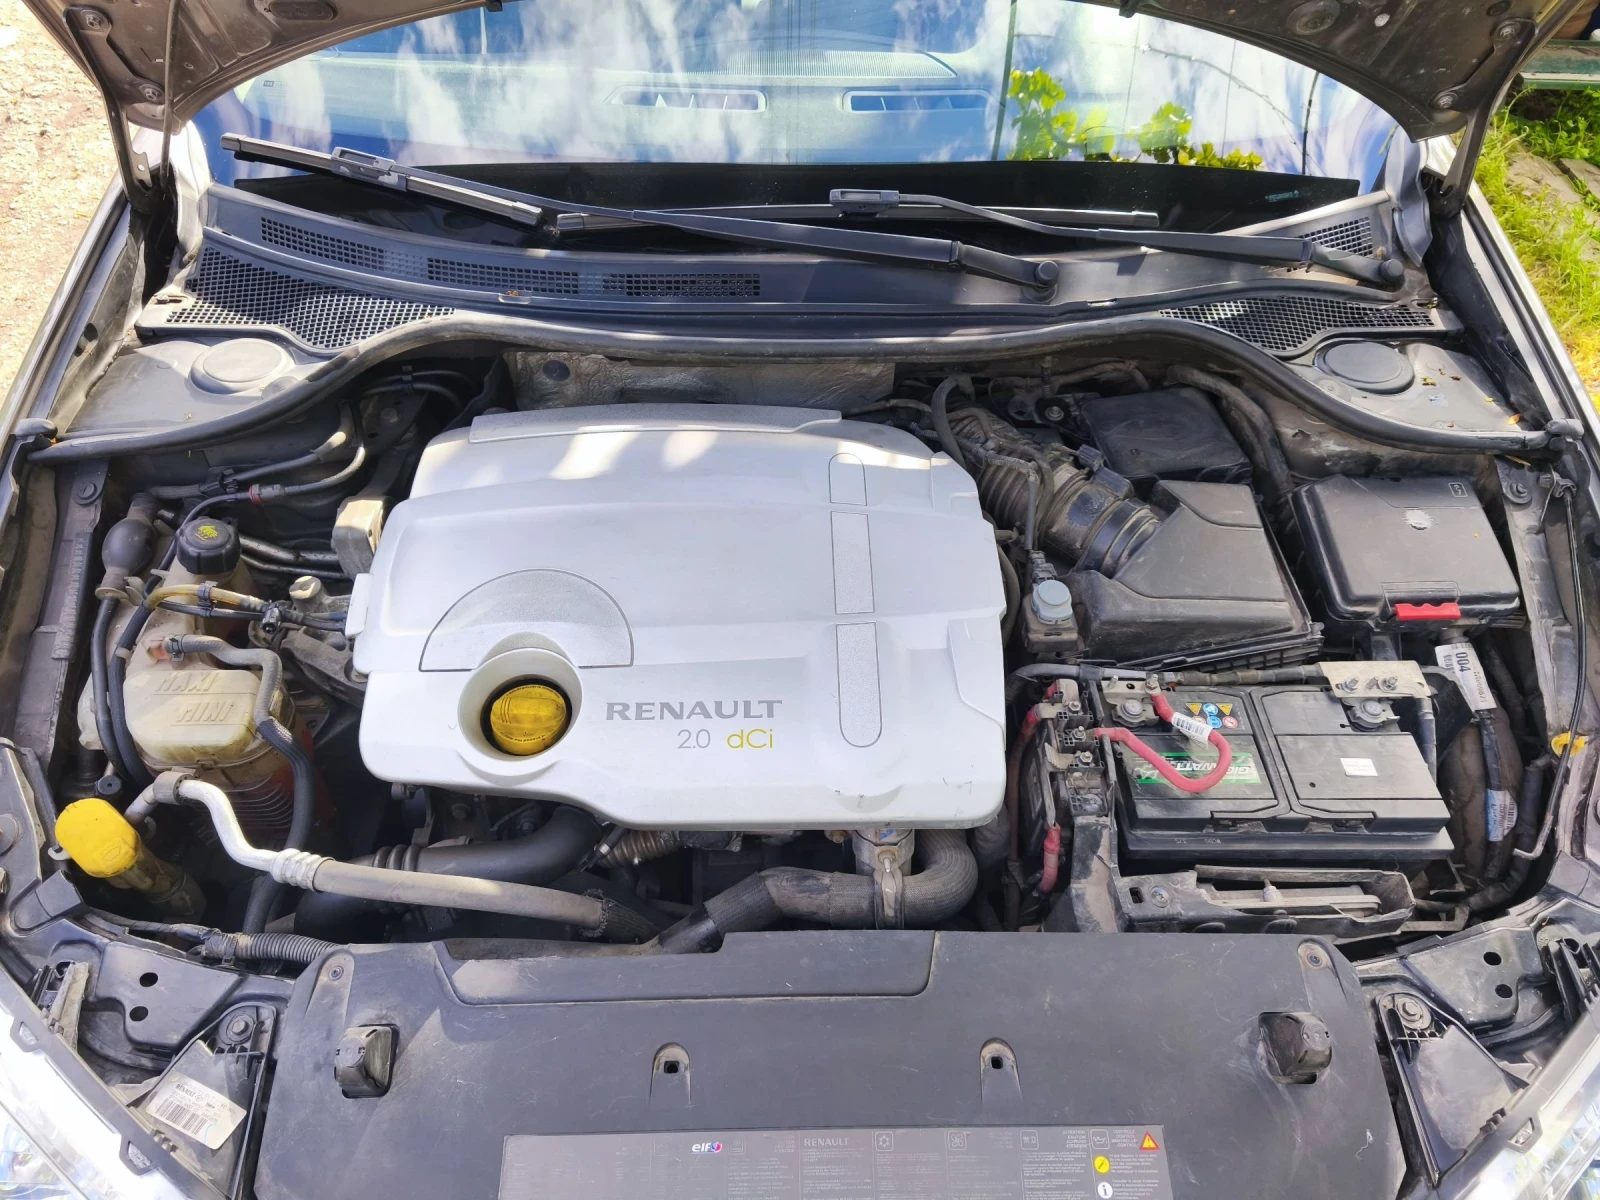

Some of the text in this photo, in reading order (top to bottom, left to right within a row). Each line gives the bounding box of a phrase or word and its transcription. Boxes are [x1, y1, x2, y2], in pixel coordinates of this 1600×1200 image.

[1455, 651, 1472, 673] 004
[155, 672, 220, 692] MAXI
[176, 700, 234, 722] MINI
[605, 699, 783, 721] RENAULT
[677, 728, 773, 749] 2.0 dCi
[1174, 761, 1252, 776] GIGWATT
[691, 1142, 711, 1152] elf
[804, 1137, 849, 1147] RENAULT
